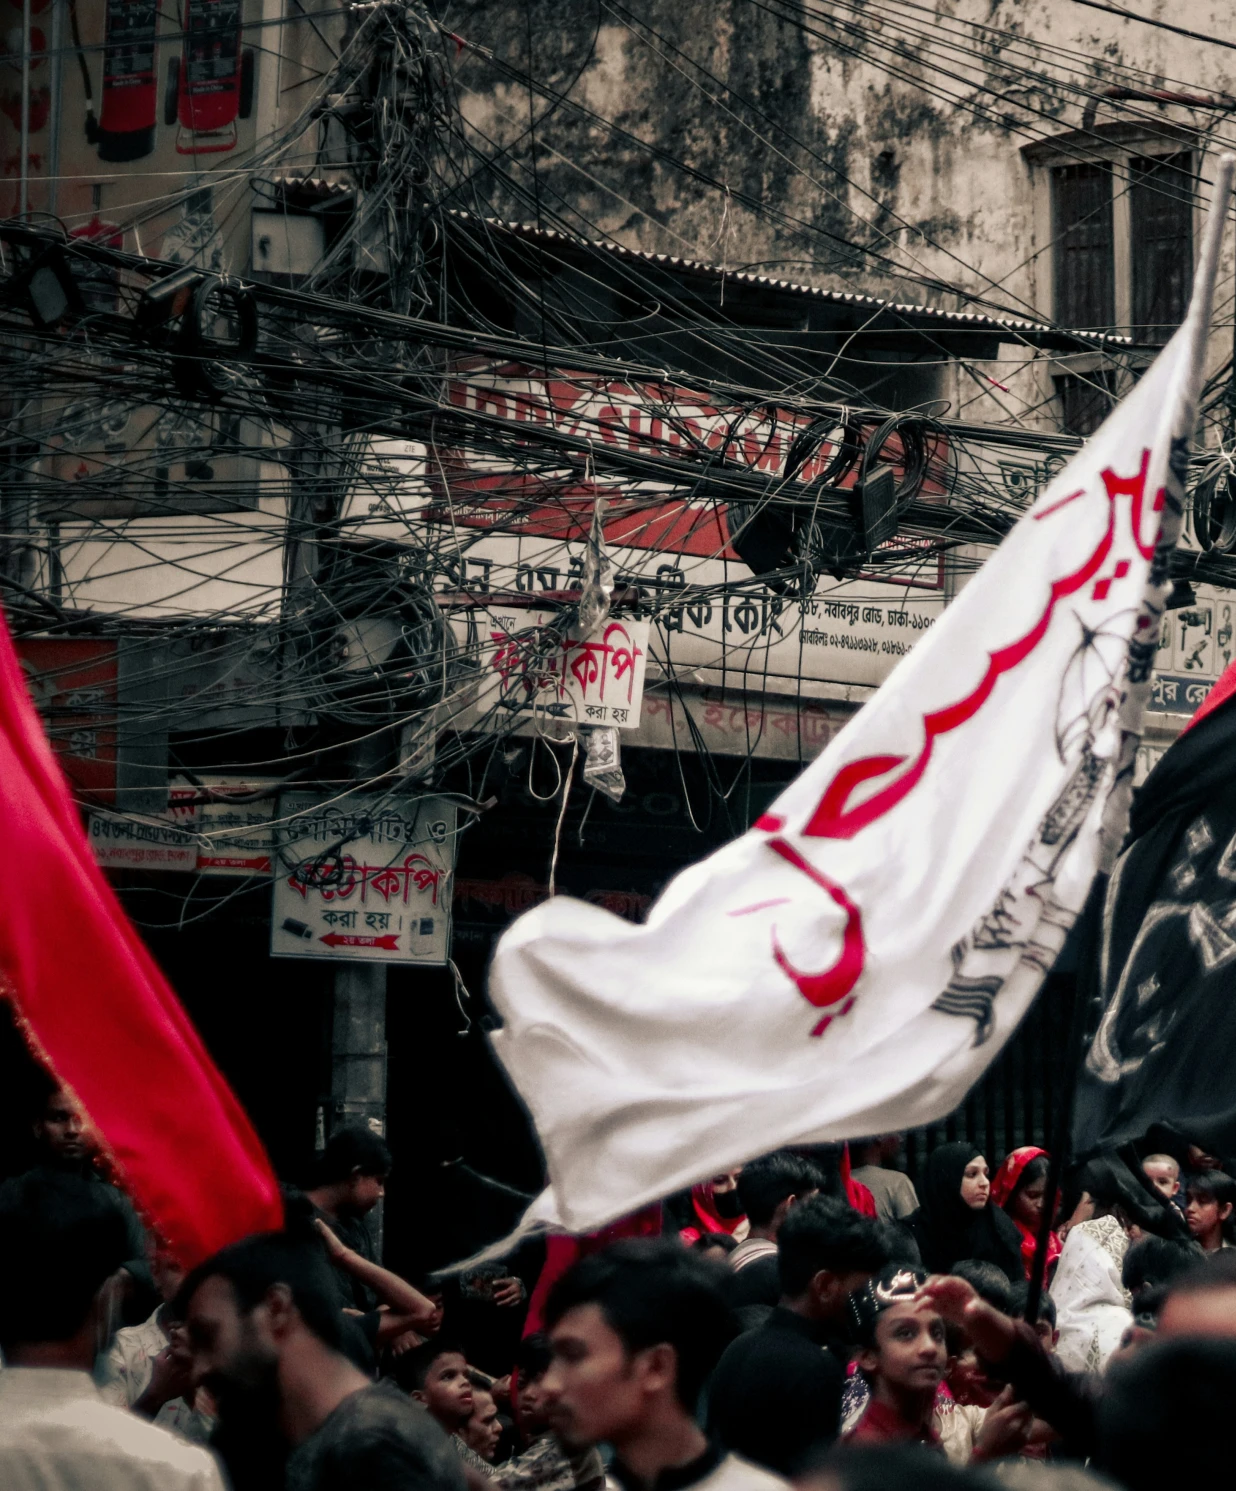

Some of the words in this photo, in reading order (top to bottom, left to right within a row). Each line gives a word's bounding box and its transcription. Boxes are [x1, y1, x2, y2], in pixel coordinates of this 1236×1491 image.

[404, 444, 416, 453] ZTE
[584, 704, 609, 721] করা
[611, 706, 629, 723] হয়
[321, 909, 360, 929] করা
